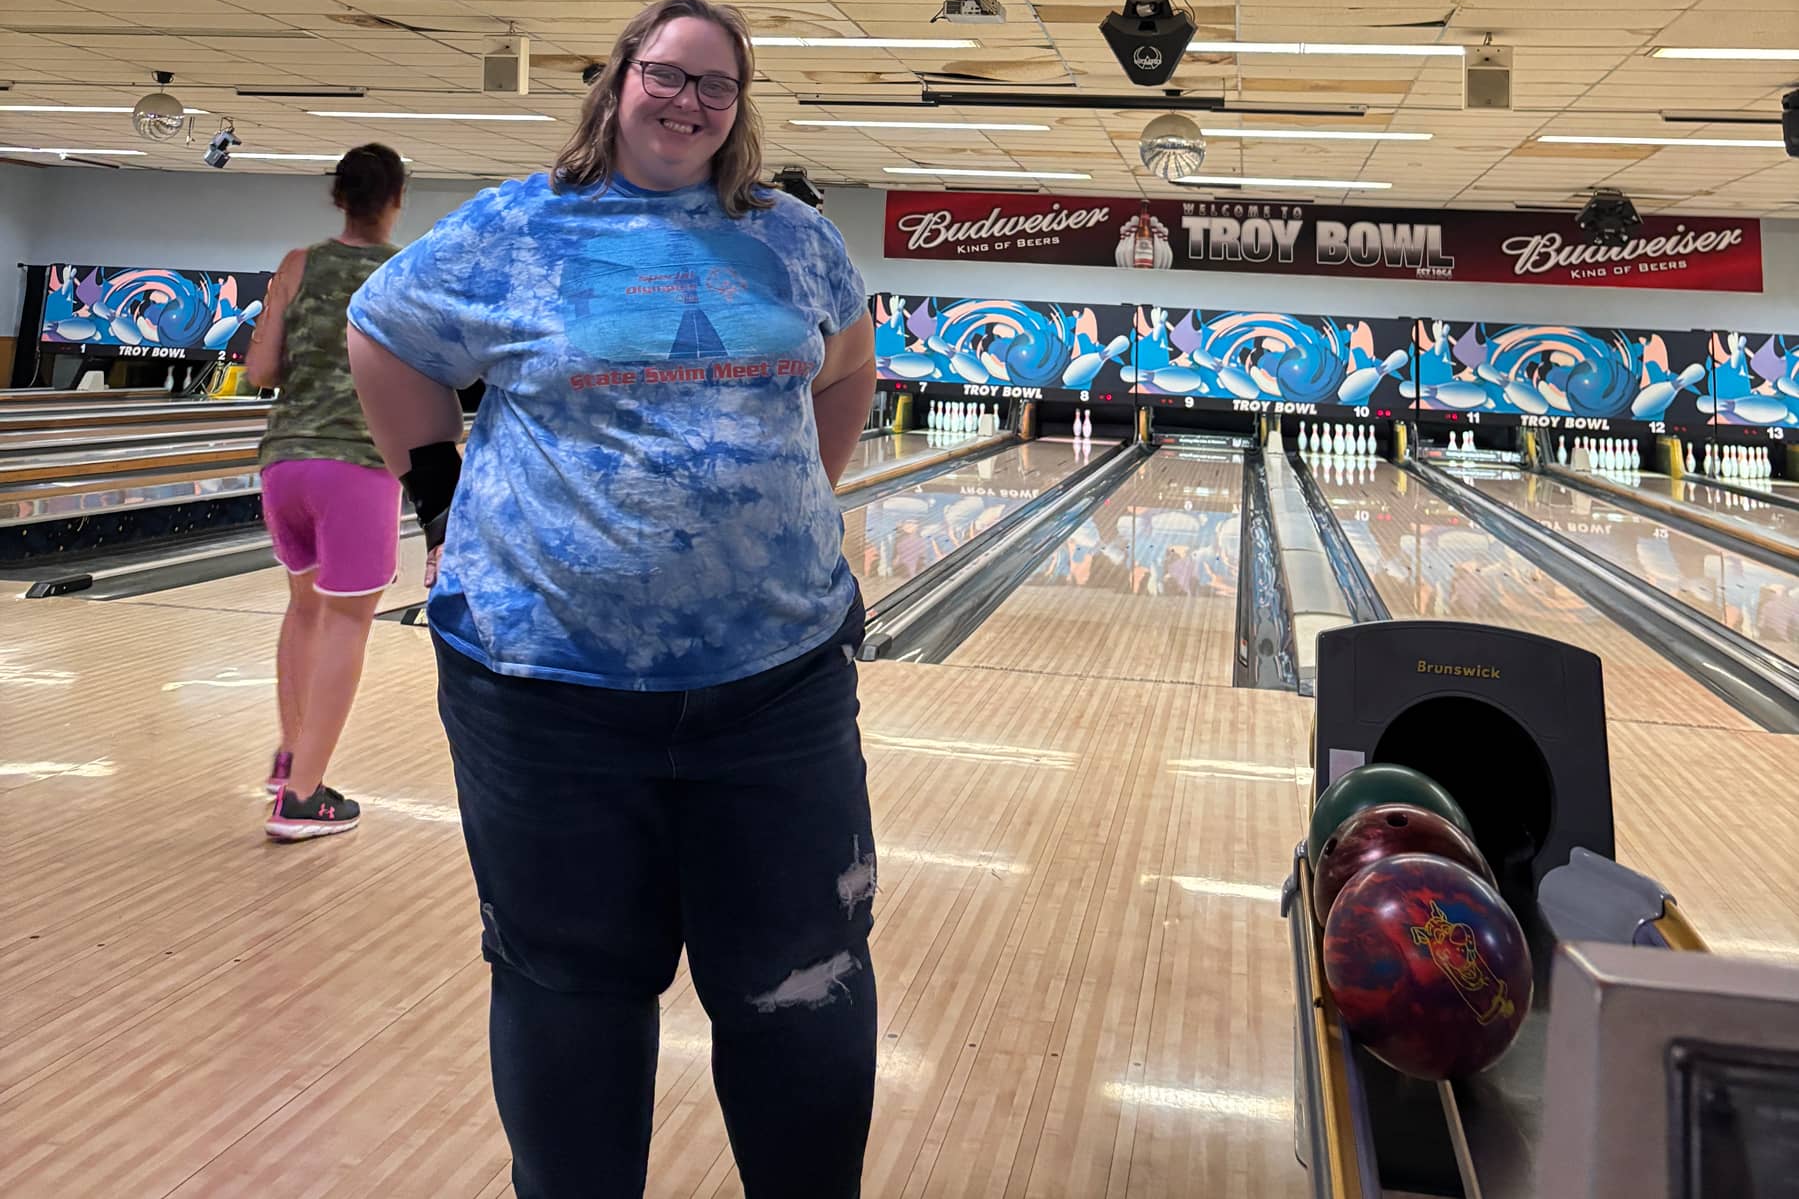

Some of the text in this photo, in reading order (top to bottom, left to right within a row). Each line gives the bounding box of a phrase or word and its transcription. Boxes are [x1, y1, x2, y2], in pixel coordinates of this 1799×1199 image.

[1182, 203, 1303, 219] WELCOME TO
[898, 202, 1110, 250] Budweiser
[1182, 216, 1455, 269] TROY BOWL
[80, 344, 226, 360] 1 TROY BOWL 2
[569, 359, 814, 392] State Swim Meet 20
[919, 381, 1089, 402] 7 TROY BOWL 8
[1184, 397, 1370, 418] 9 TROY BOWL 10
[1466, 411, 1665, 434] 11 TROY BOWL 12
[1767, 427, 1784, 440] 13
[1416, 660, 1501, 680] Brunswick
